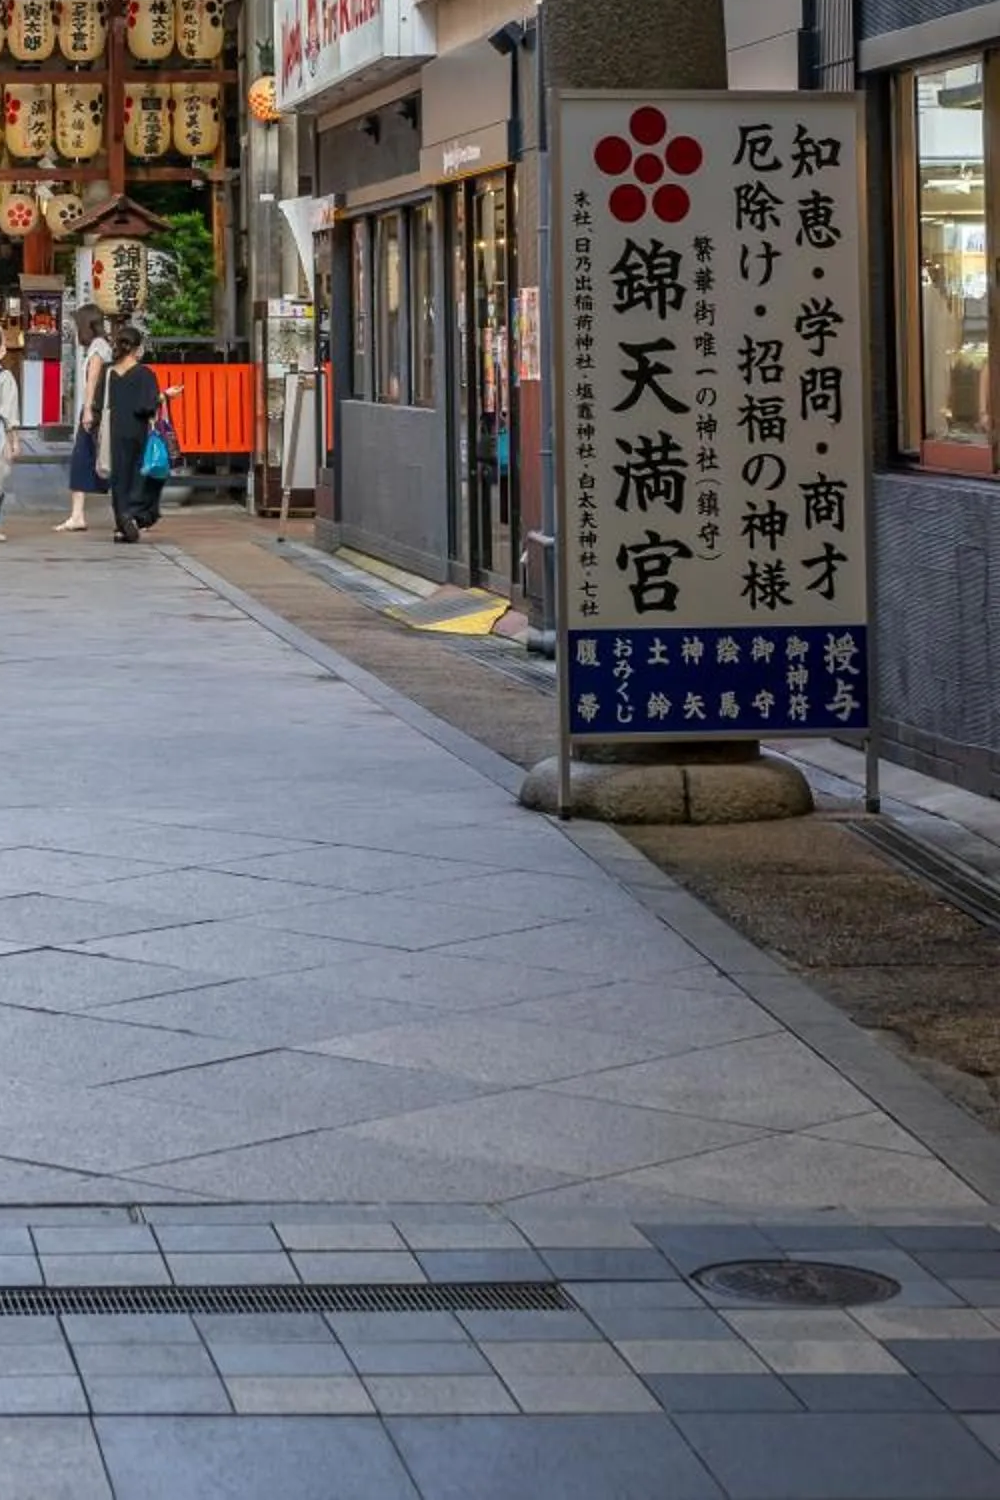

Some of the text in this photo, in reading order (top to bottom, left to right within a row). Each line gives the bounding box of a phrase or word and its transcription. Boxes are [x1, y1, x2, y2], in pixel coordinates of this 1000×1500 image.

[111, 243, 141, 314] 錦天満宮
[732, 123, 794, 611] 厄除け・招福の神様
[790, 124, 850, 601] 知恵・学問・商才
[609, 237, 694, 615] 錦天満宮
[611, 637, 636, 724] おみくじ
[646, 637, 673, 721] 土鈴
[680, 636, 707, 720] 神矢
[715, 635, 742, 719] 絵馬
[750, 635, 776, 719] 御守
[823, 631, 861, 723] 授与
